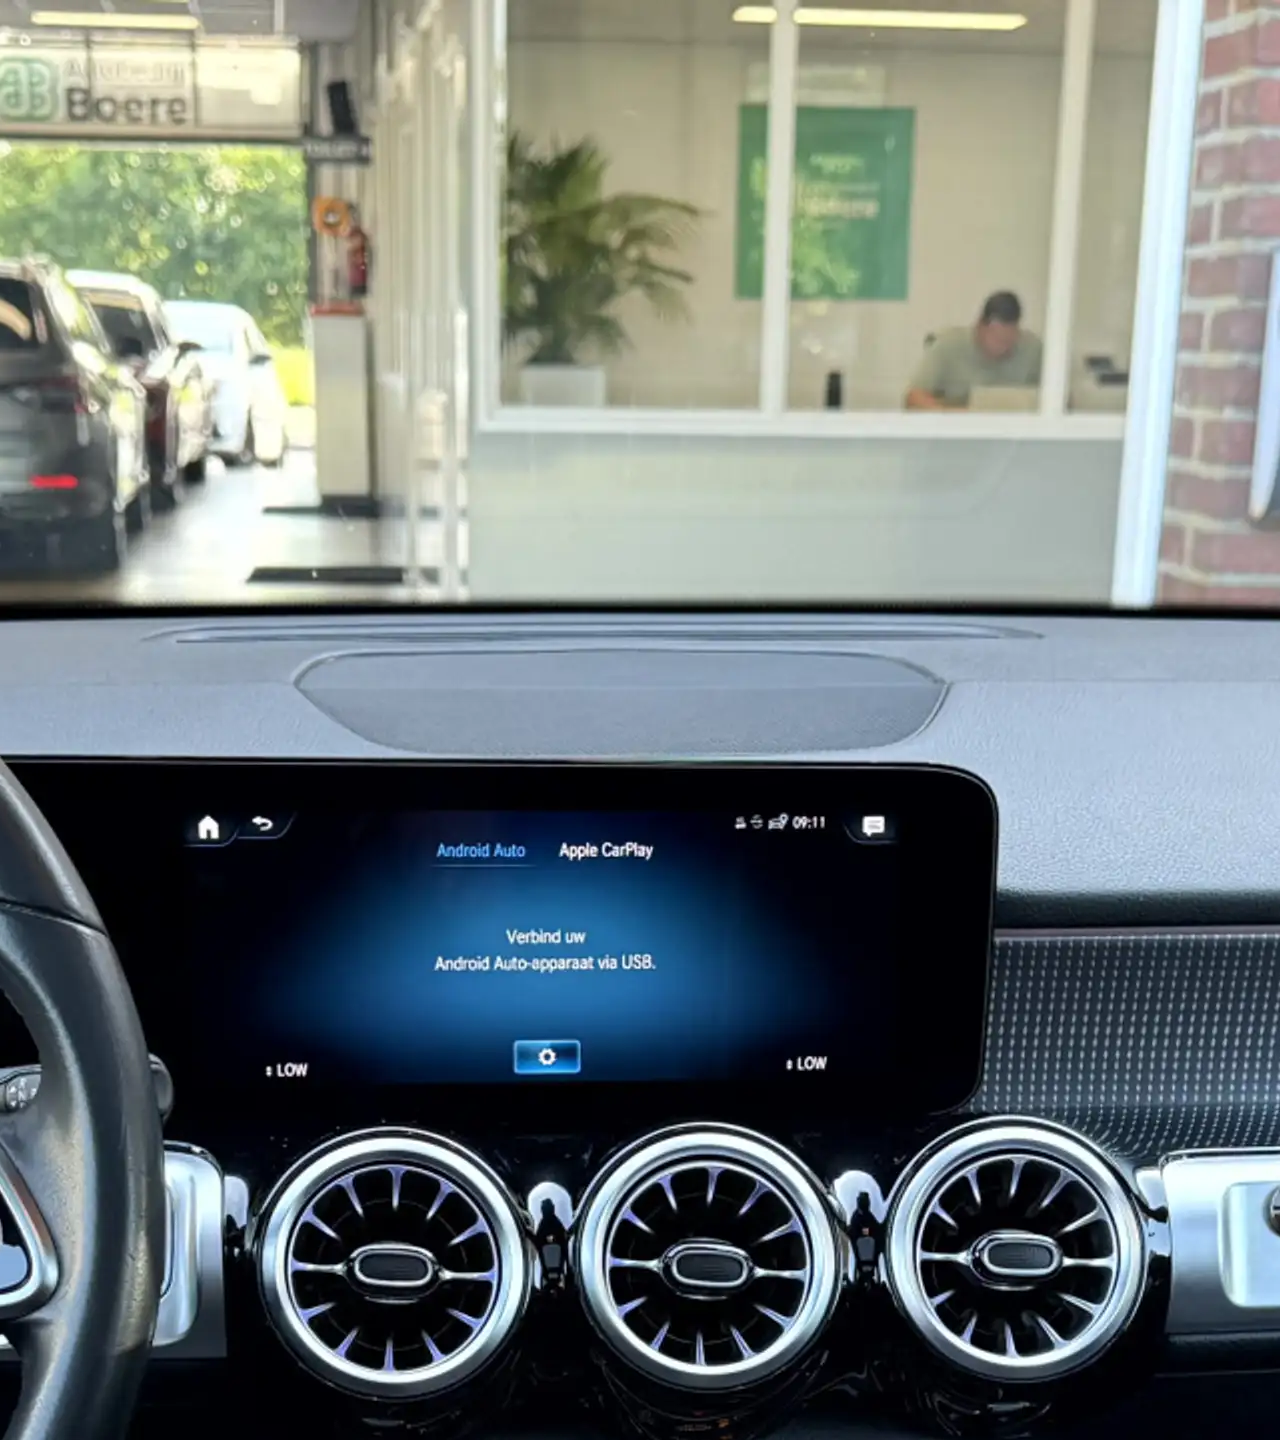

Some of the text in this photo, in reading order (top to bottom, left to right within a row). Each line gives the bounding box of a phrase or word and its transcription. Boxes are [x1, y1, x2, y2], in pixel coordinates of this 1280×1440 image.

[66, 87, 188, 123] Boere
[792, 815, 825, 829] 09:11
[436, 844, 526, 858] Android Auto
[559, 842, 654, 861] Apple CarPlay
[506, 929, 586, 944] Verbind uw
[435, 955, 656, 973] Android Auto-apparaat via USB.
[276, 1062, 308, 1077] LOW
[797, 1055, 827, 1071] LOW
